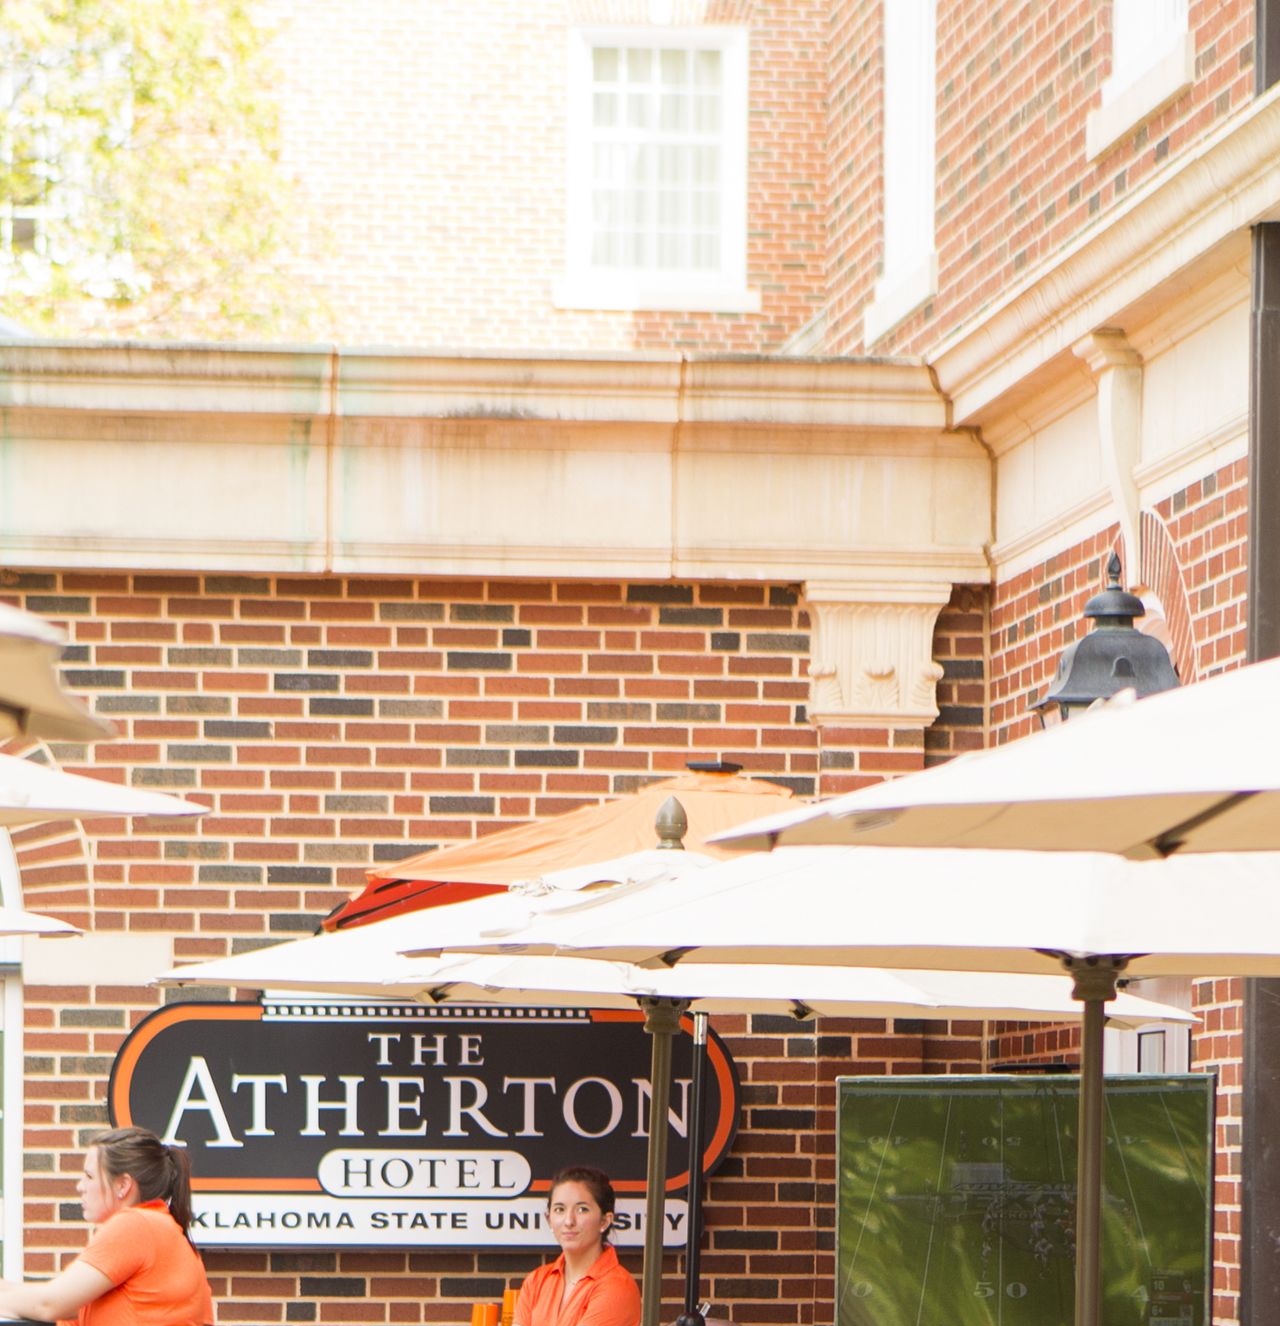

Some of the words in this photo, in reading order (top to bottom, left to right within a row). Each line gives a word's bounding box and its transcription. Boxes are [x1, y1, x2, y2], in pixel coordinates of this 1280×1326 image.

[367, 1032, 486, 1067] THE
[159, 1055, 694, 1149] ATHERTON
[340, 1157, 517, 1190] HOTEL
[189, 1211, 356, 1230] KLAHOMA
[369, 1211, 469, 1230] STATE
[484, 1212, 687, 1231] UNISIY
